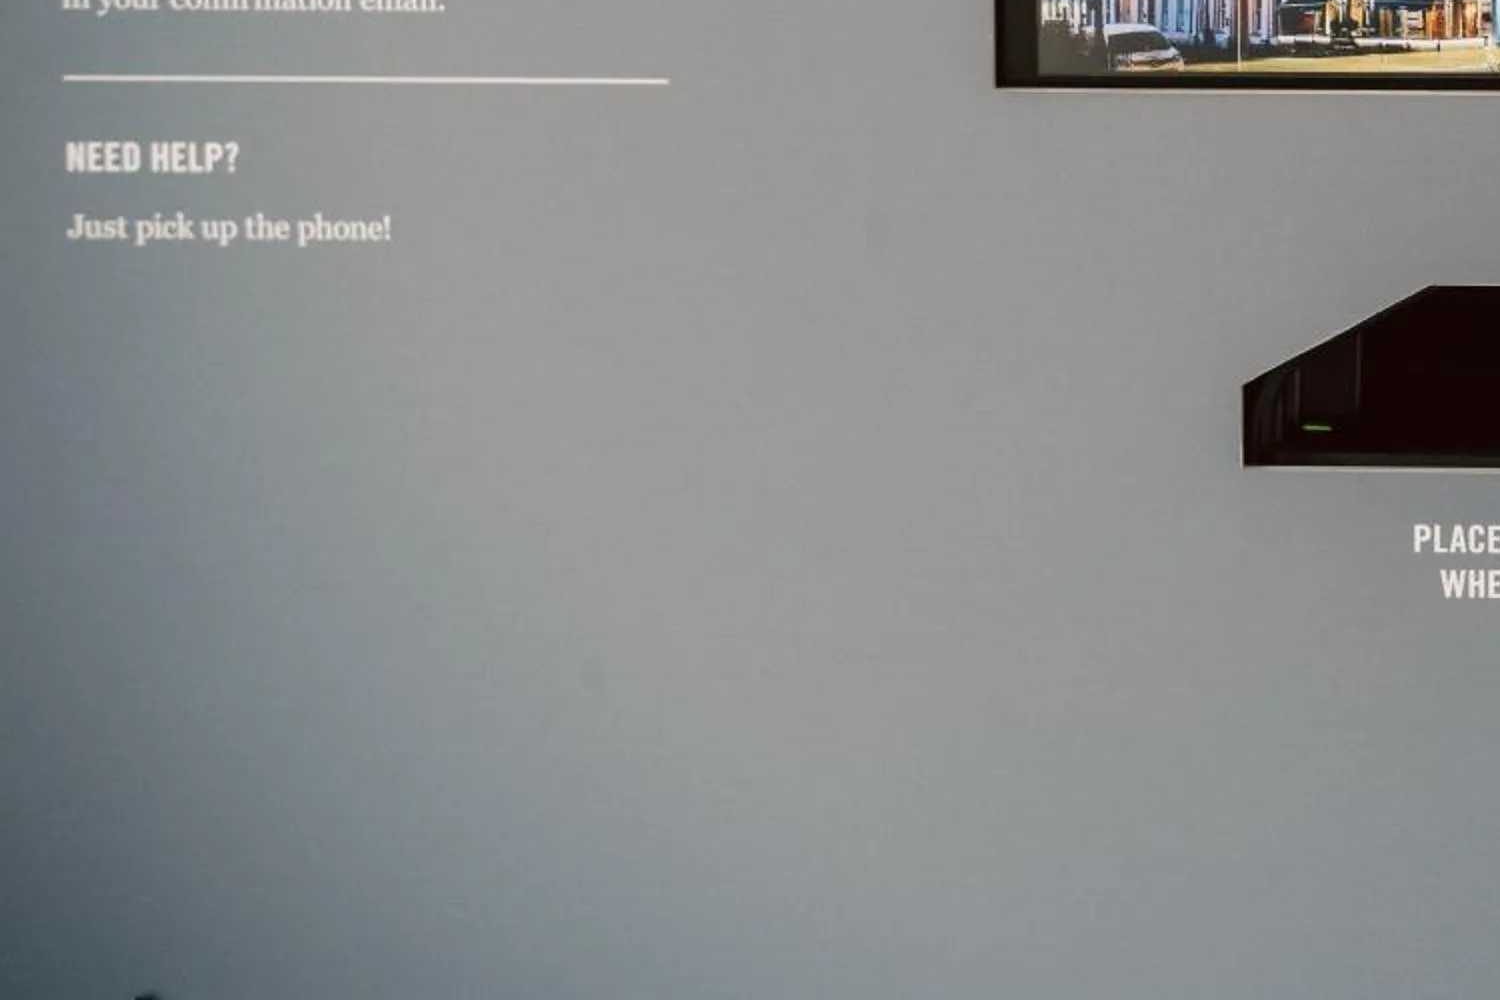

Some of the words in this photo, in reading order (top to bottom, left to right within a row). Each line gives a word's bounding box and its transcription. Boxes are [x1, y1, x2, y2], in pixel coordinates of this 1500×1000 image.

[65, 141, 141, 173] NEED
[150, 141, 240, 174] HELP?
[66, 212, 128, 240] Just
[136, 211, 195, 247] pick
[200, 218, 239, 248] up
[244, 211, 291, 241] the
[296, 211, 392, 248] phone!
